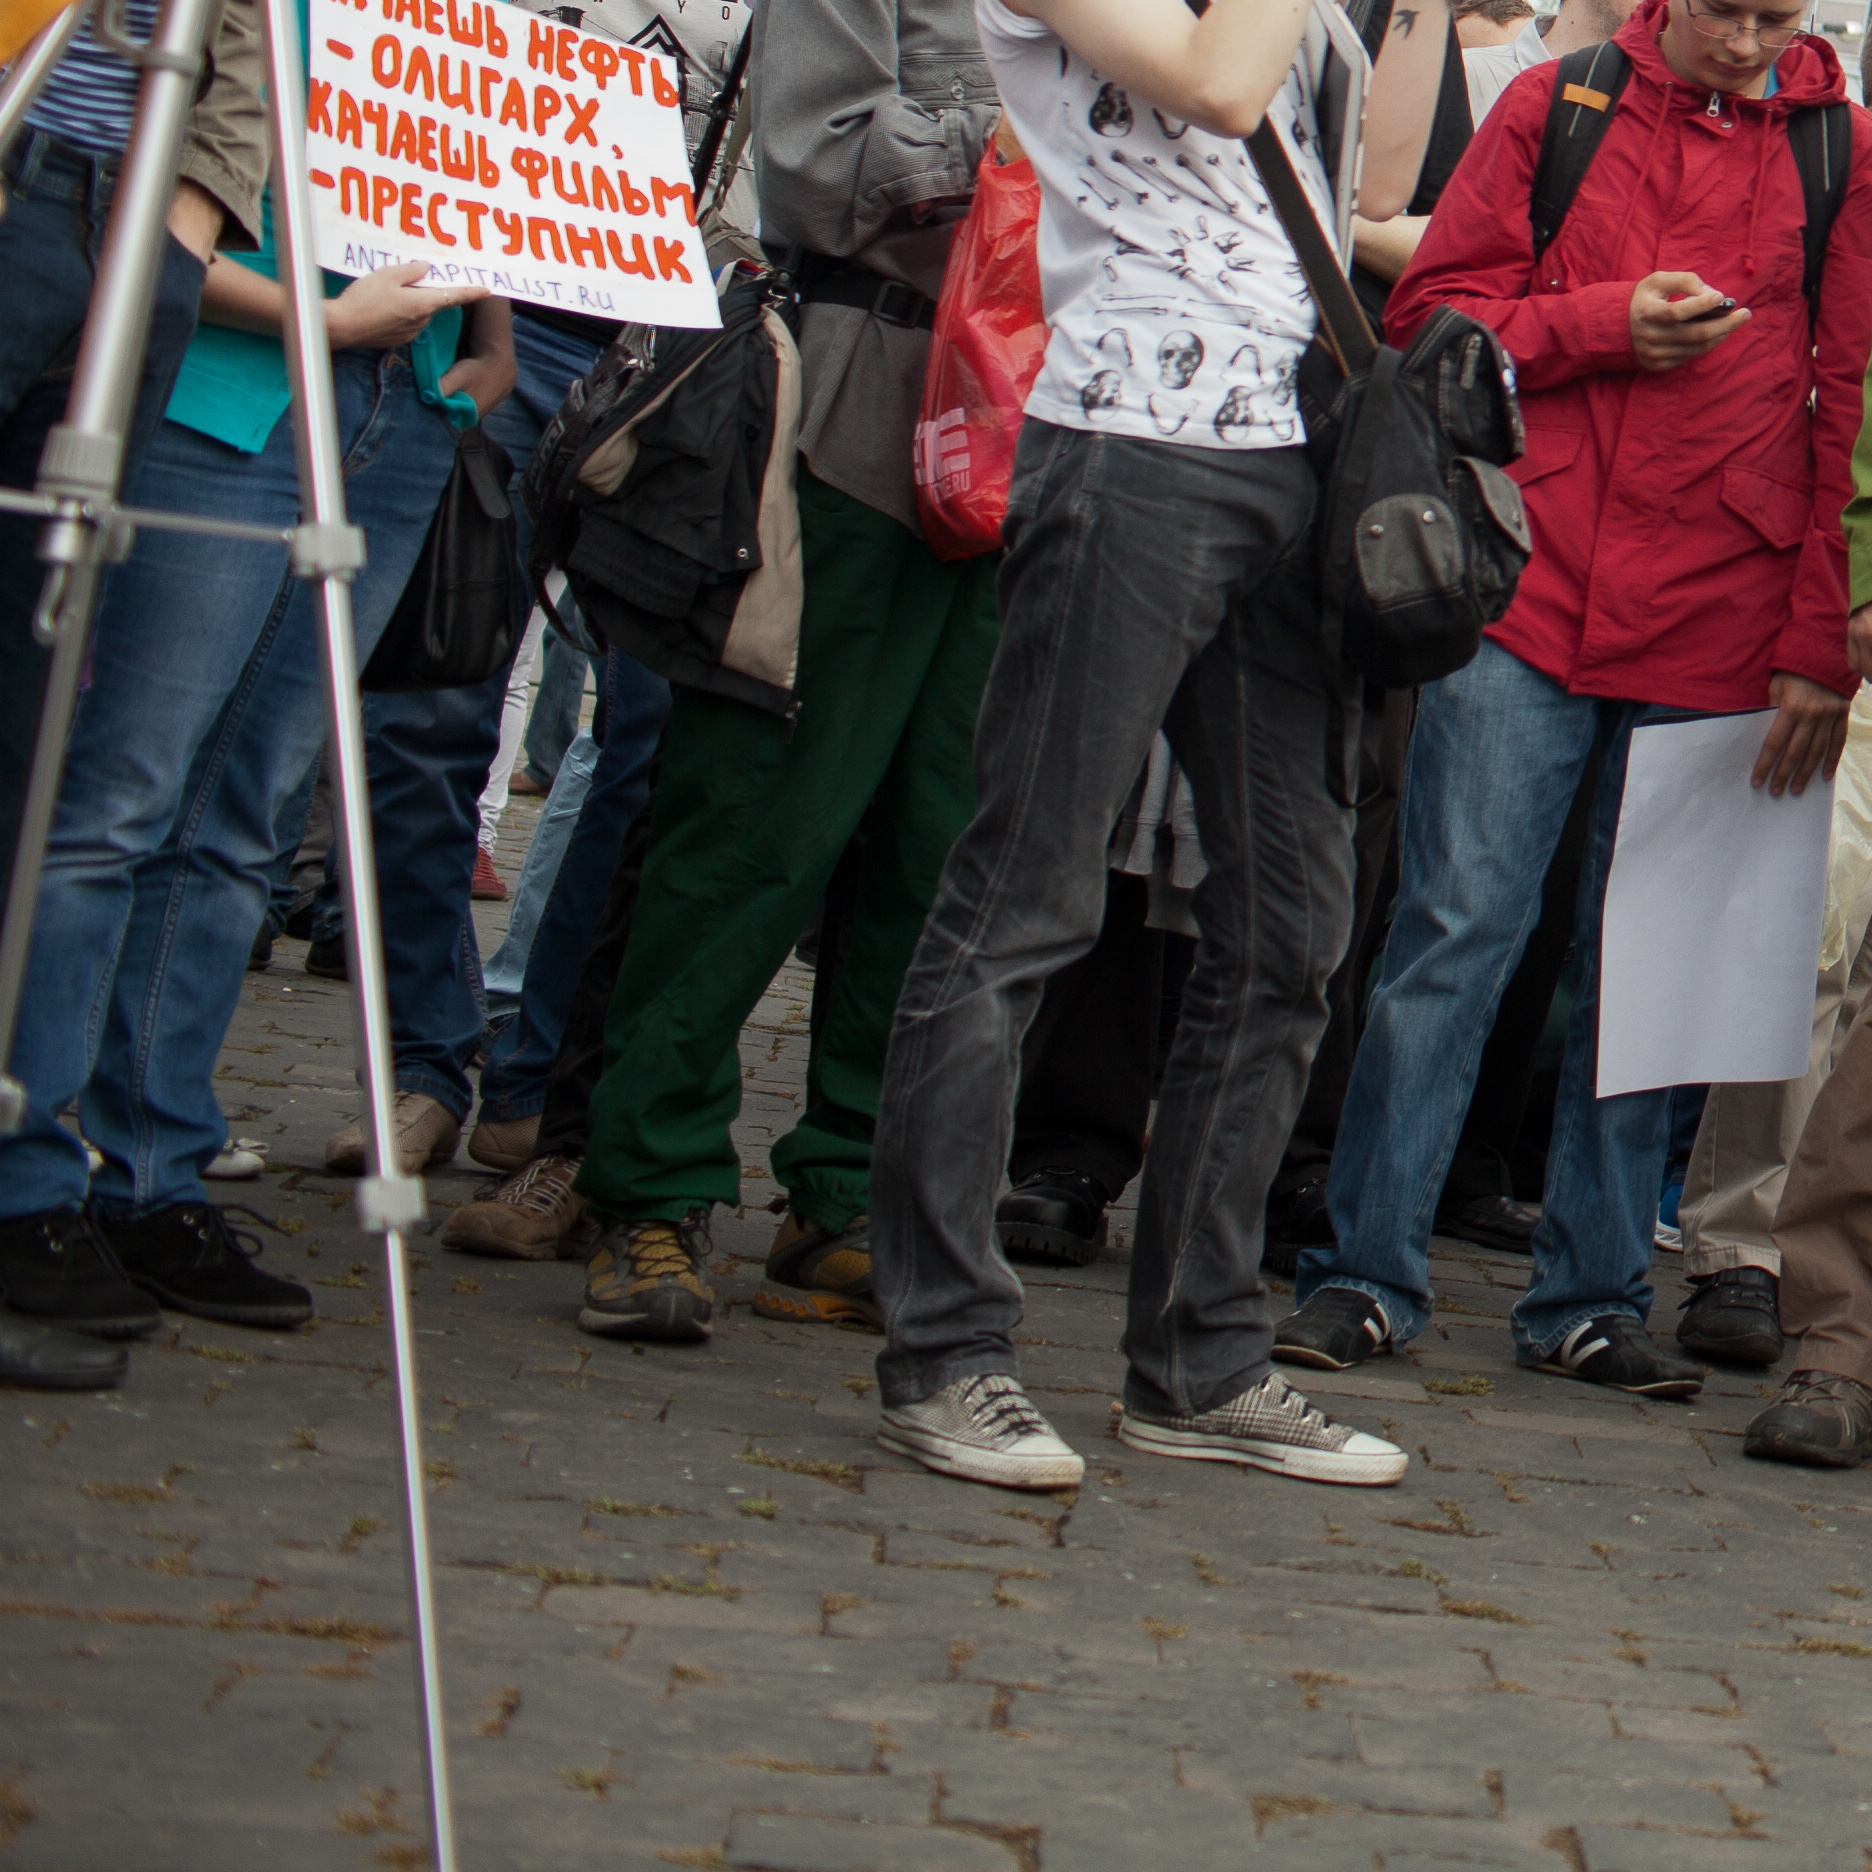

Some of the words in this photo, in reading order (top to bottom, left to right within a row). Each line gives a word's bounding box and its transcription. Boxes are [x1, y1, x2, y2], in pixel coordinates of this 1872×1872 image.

[528, 18, 680, 108] НЕФТЬ
[307, 77, 500, 188] КАЧАЕШЬ
[511, 146, 698, 228] ФИЛЬМ
